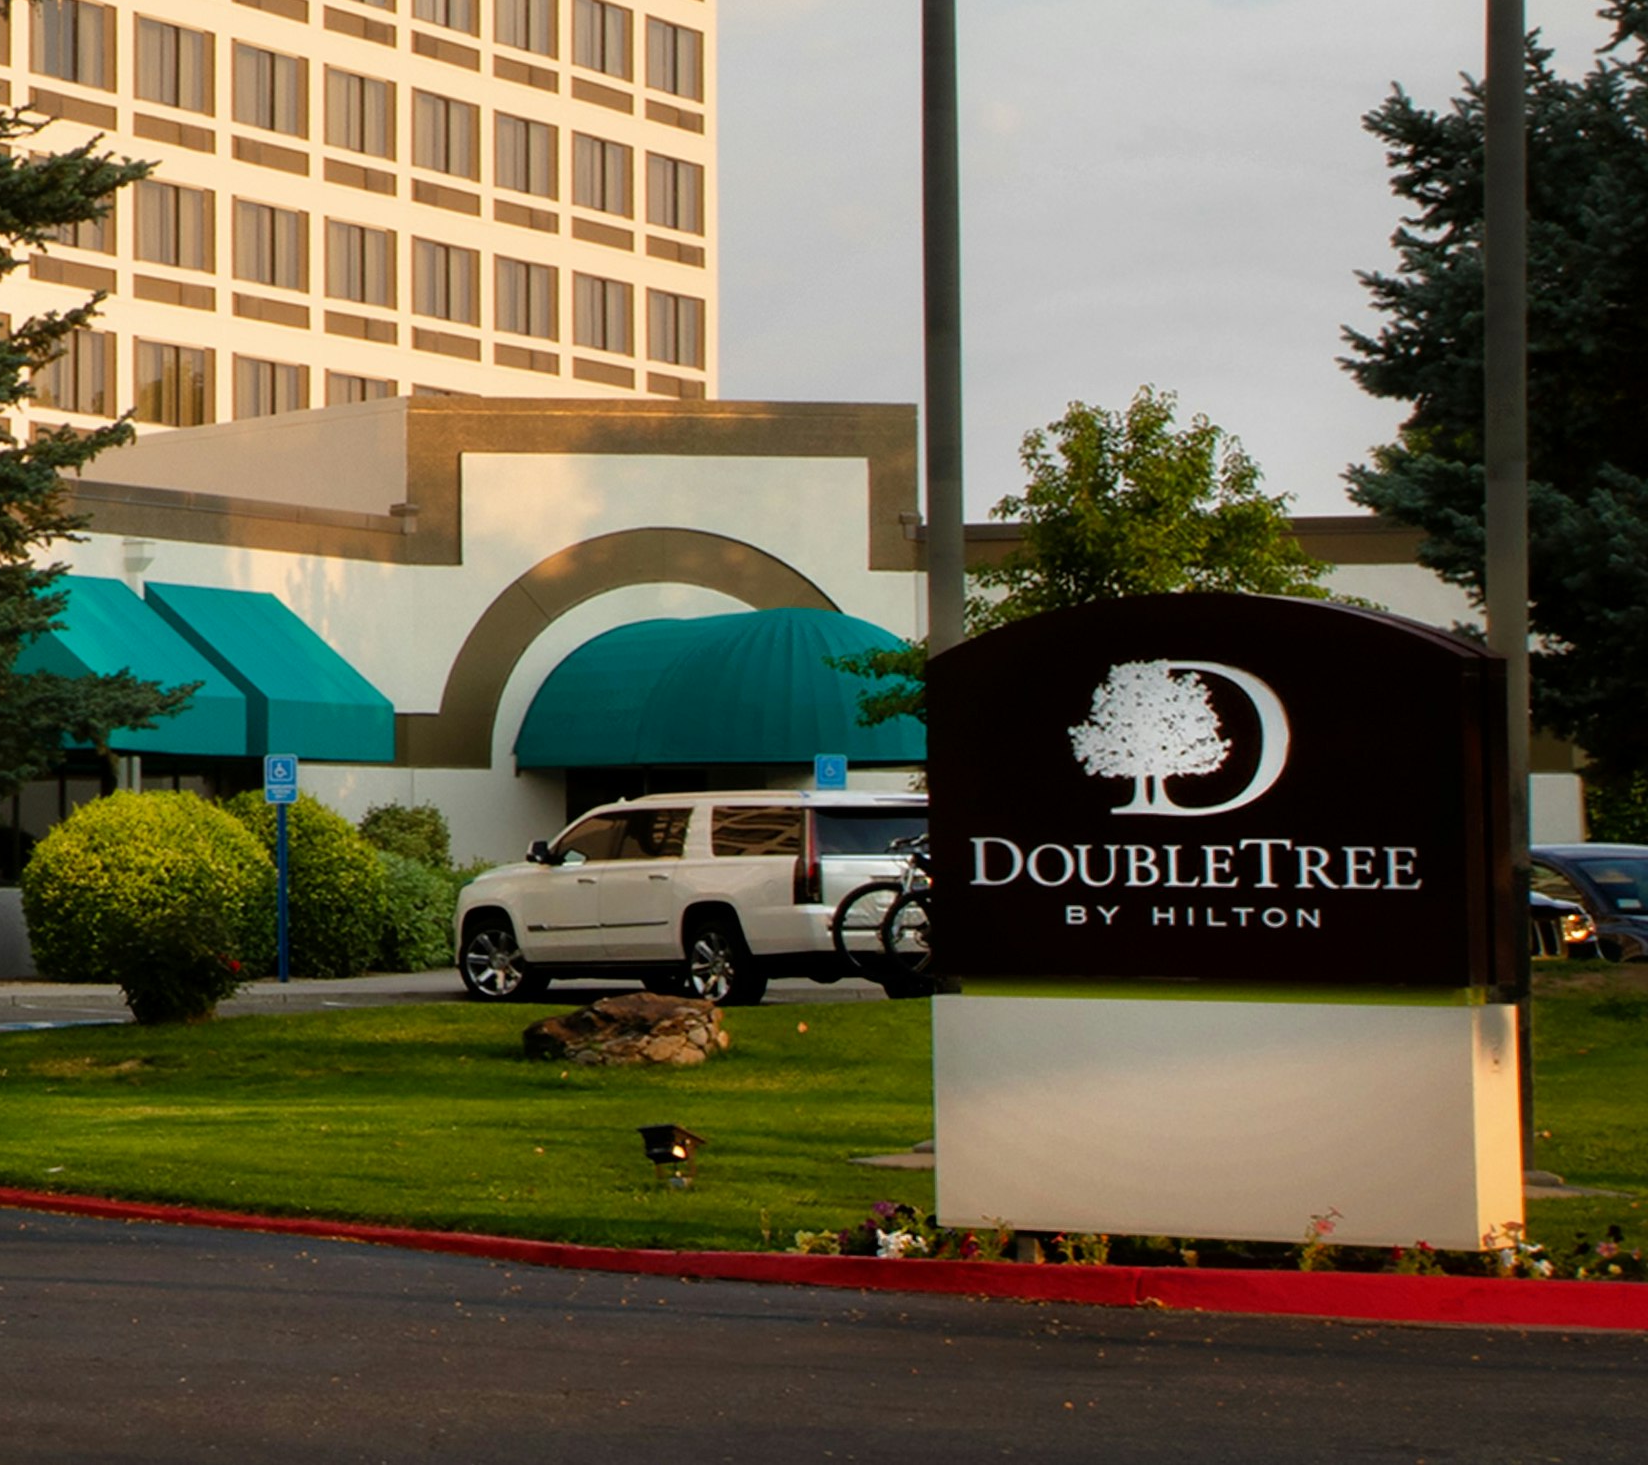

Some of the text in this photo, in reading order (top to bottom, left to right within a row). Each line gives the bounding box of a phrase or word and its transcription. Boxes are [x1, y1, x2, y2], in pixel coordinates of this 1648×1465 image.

[969, 836, 1423, 890] DOUBLETREE
[1065, 904, 1321, 929] BY HILTON
